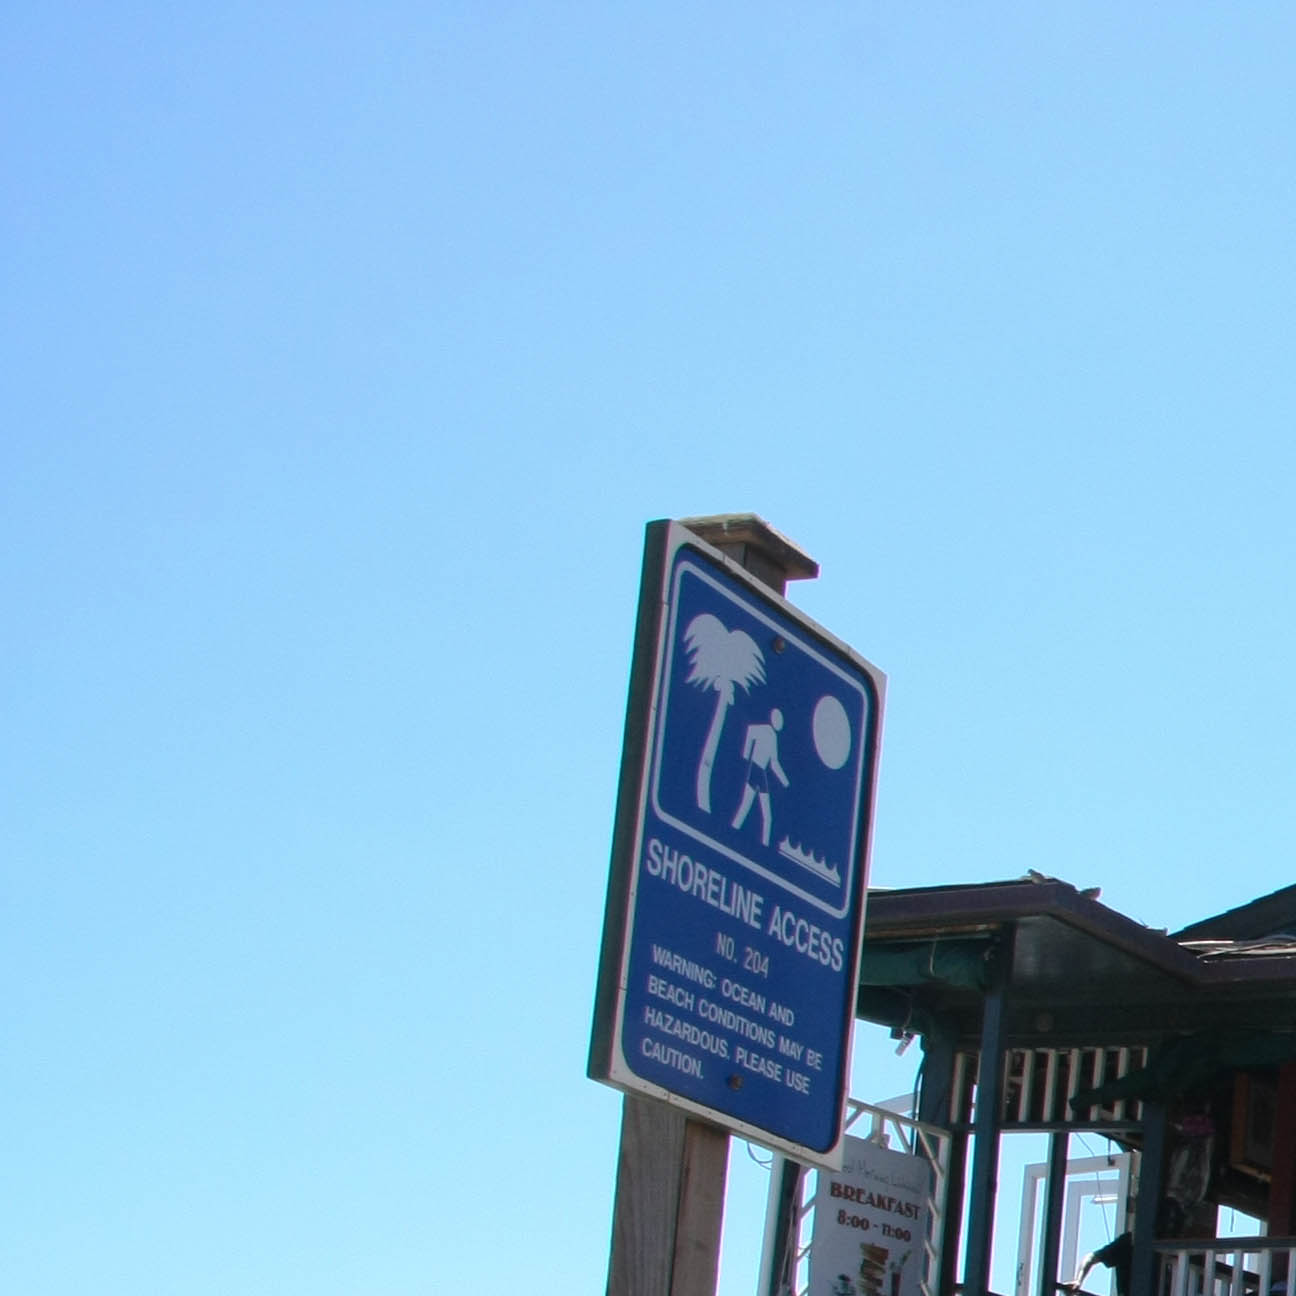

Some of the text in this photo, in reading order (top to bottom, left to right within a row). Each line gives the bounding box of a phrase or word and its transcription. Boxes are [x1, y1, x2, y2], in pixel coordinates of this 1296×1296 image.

[647, 838, 845, 972] SHORELINE ACCESS
[652, 944, 795, 1027] WARNING: OCEAN AND
[716, 931, 770, 979] NO. 204
[644, 1006, 811, 1095] HAZARDOUS. PLEASE USE
[648, 974, 824, 1071] BEACH CONDITIONS MAY BE
[642, 1037, 704, 1080] CAUTION.
[830, 1181, 921, 1220] BREAKFAST
[838, 1208, 870, 1231] 8:00
[882, 1223, 912, 1243] 11:00
